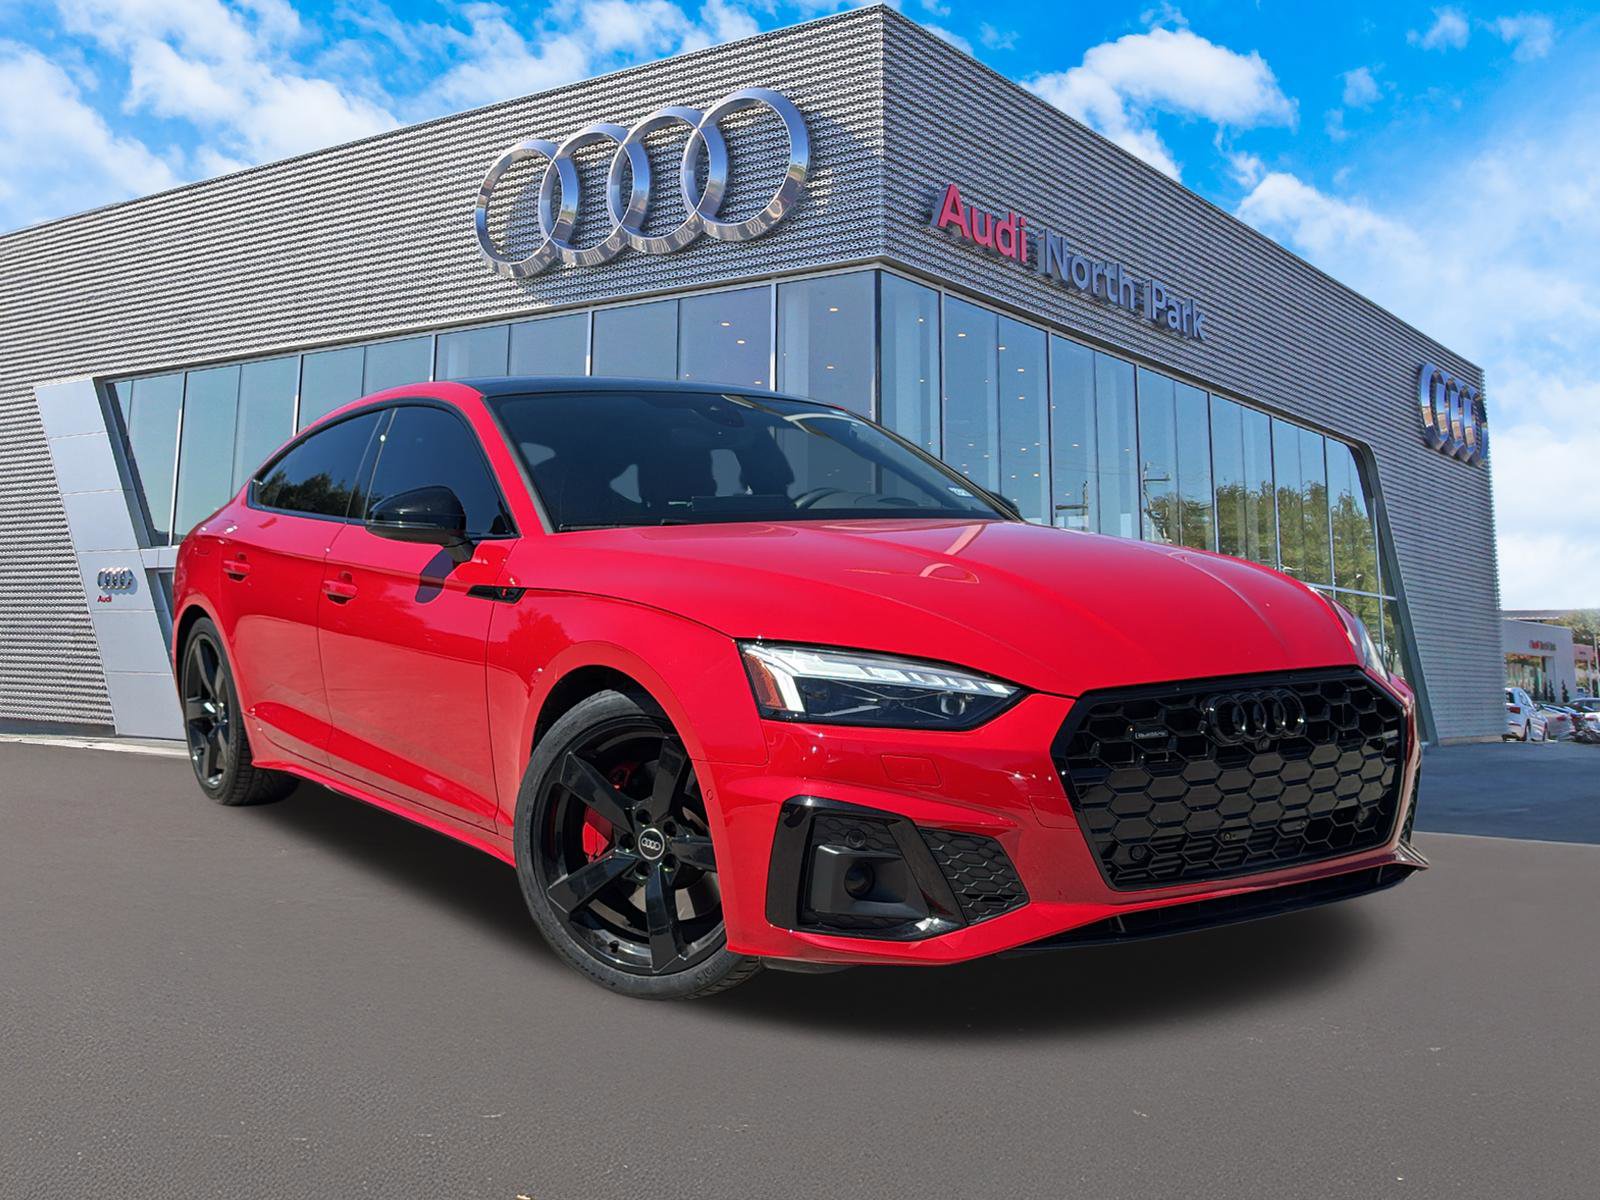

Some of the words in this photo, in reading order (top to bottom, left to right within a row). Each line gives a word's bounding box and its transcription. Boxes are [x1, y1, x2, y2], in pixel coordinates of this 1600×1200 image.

[932, 184, 1028, 263] Audi
[1040, 229, 1136, 311] North
[1146, 279, 1206, 339] Park
